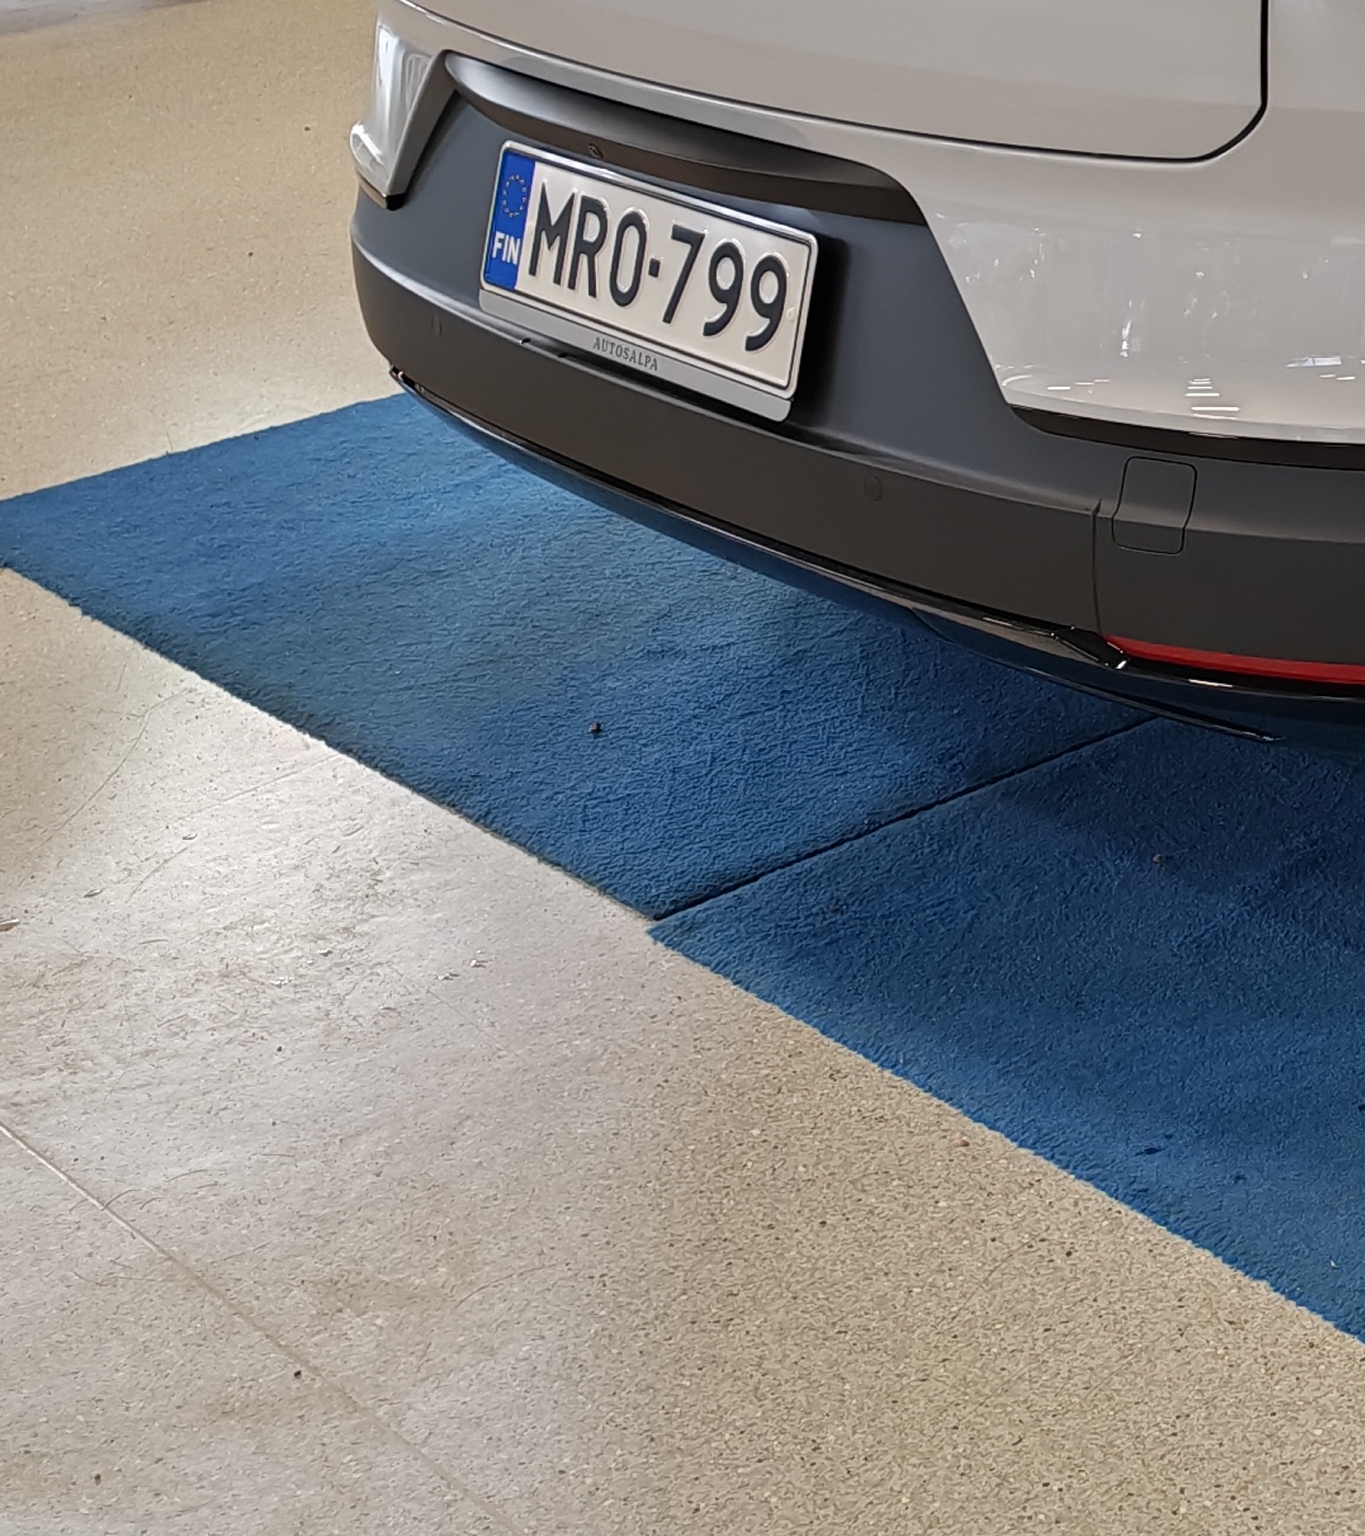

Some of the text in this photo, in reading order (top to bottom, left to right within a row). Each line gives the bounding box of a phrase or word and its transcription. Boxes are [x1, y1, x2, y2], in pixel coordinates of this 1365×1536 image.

[491, 180, 789, 353] FIN MRO-799
[592, 336, 659, 372] AUTOSALPA
